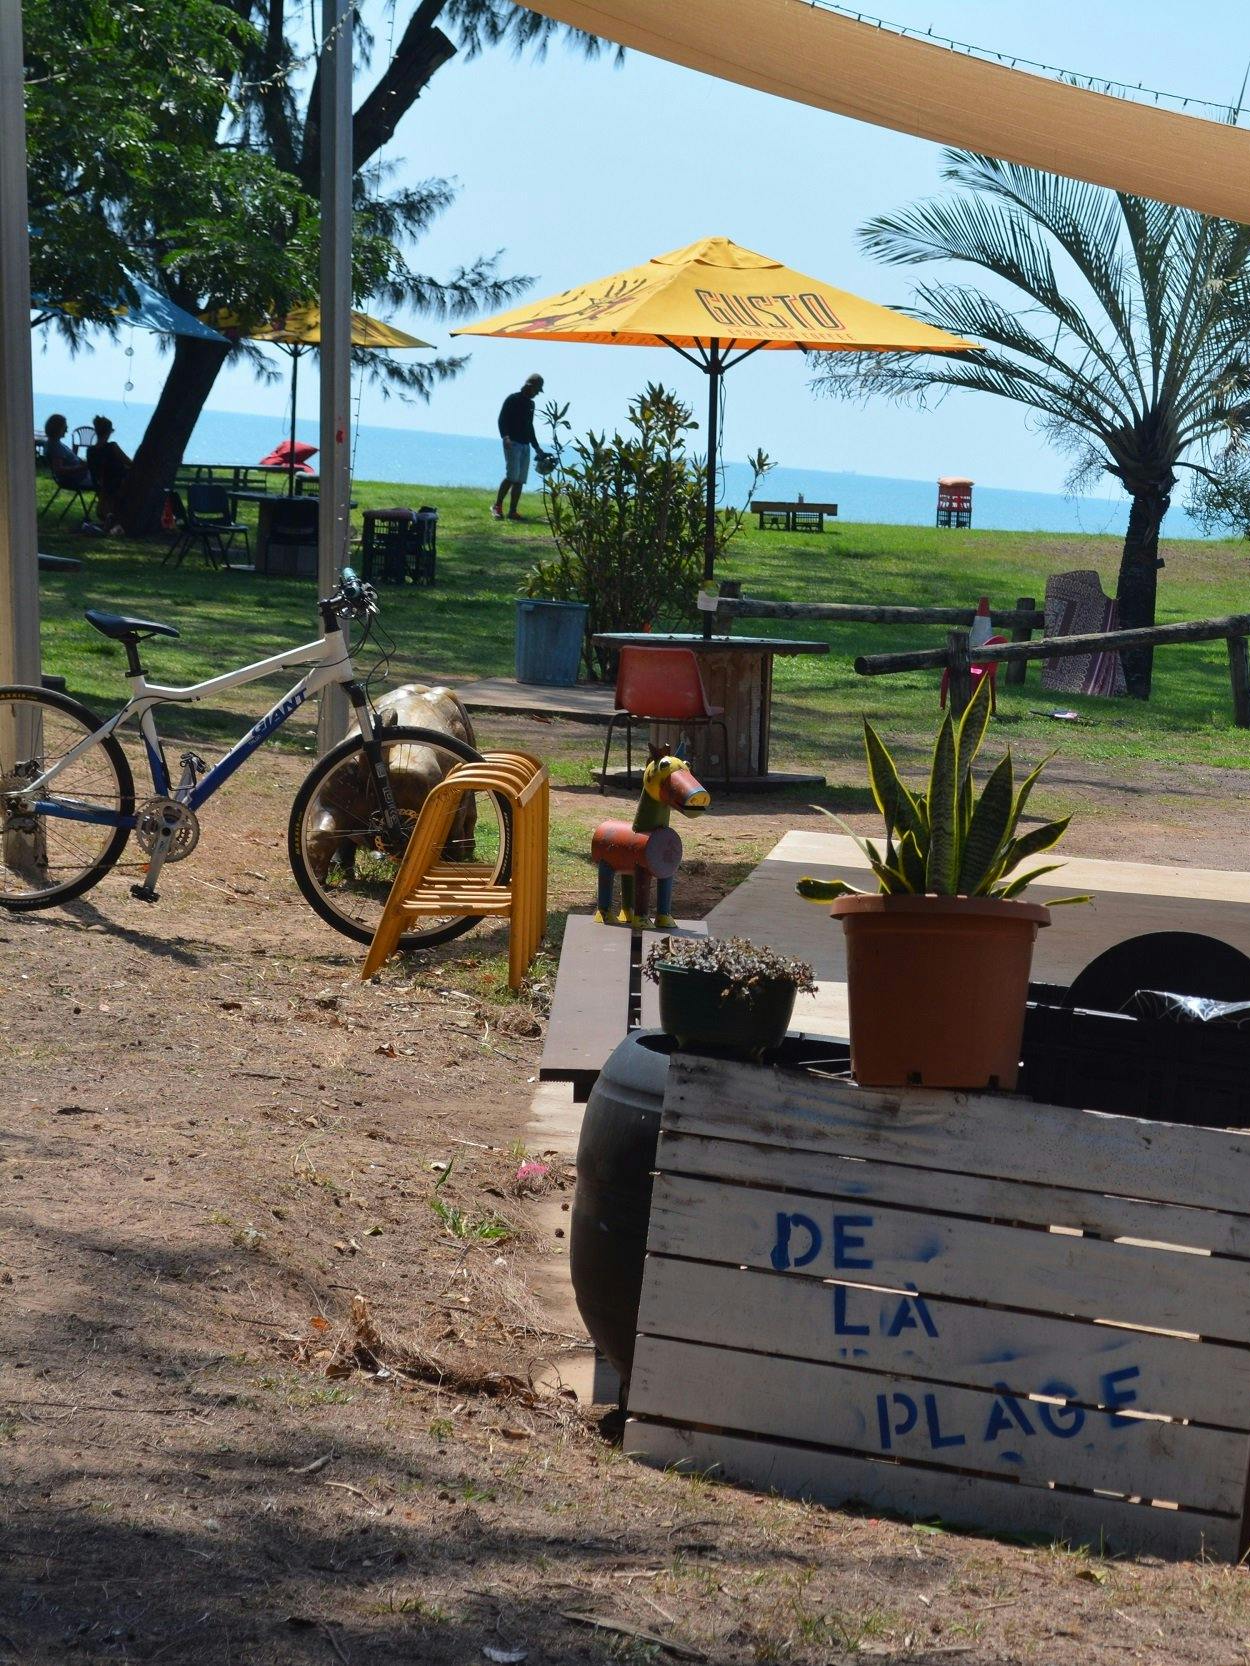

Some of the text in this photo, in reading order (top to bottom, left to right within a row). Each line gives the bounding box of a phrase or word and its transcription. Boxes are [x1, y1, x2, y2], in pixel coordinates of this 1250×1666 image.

[695, 288, 846, 331] GUSTO
[251, 687, 307, 737] GIANT
[770, 1211, 874, 1271] DE
[833, 1282, 939, 1338] LA
[876, 1365, 1146, 1450] PLAGE
